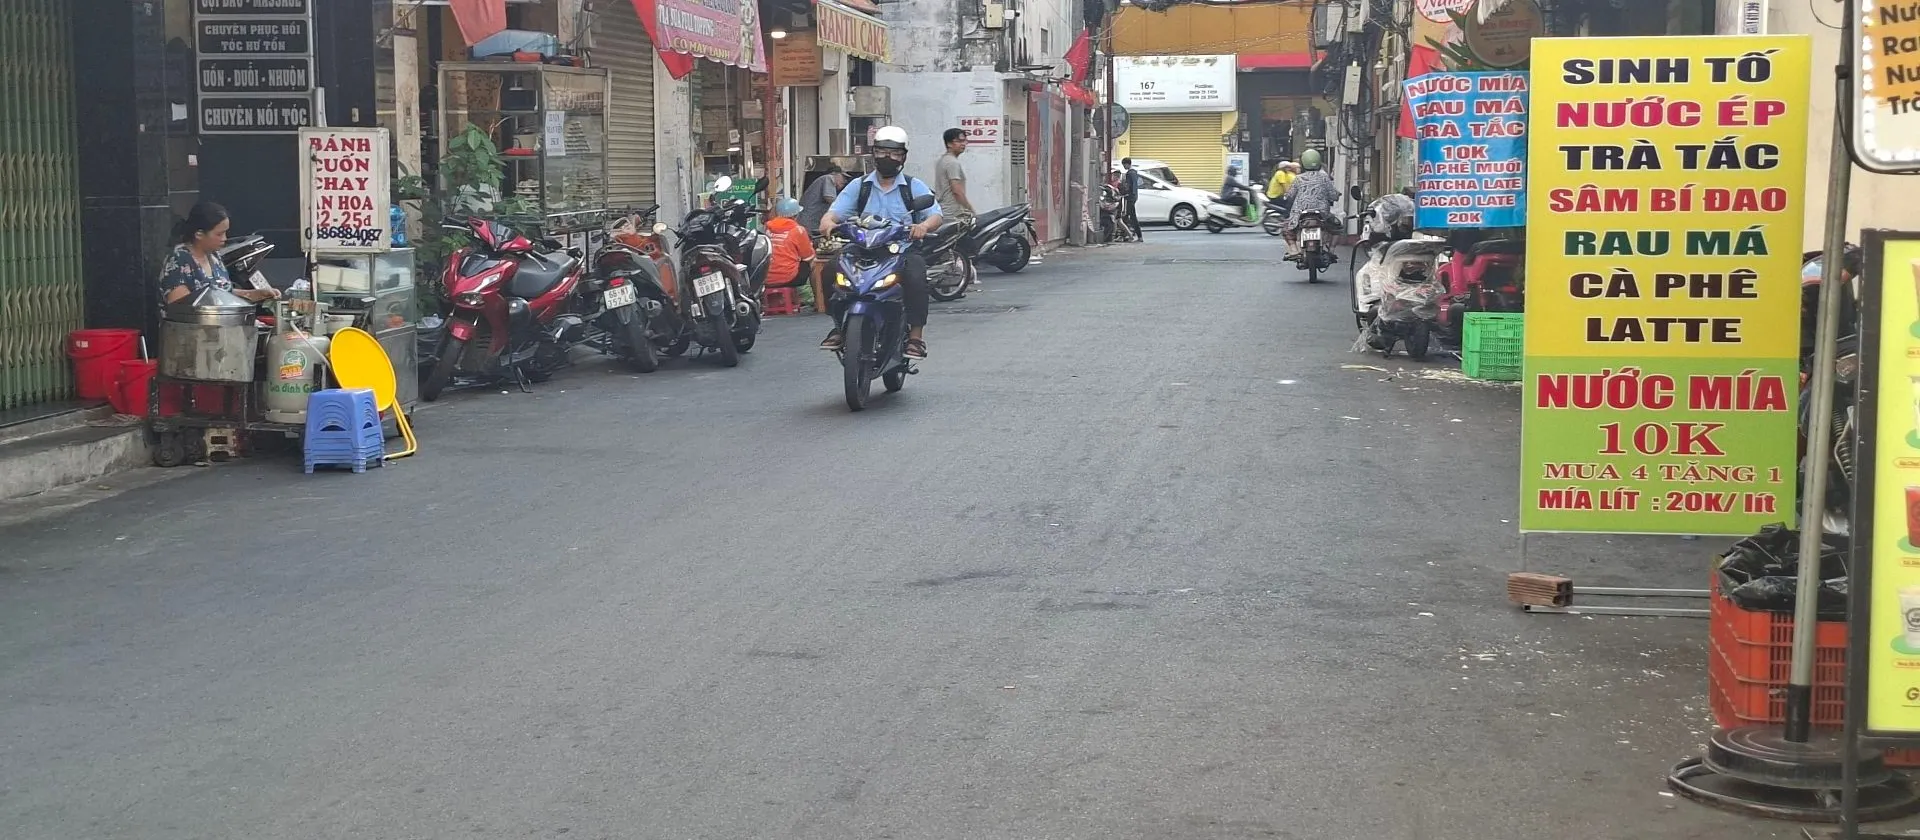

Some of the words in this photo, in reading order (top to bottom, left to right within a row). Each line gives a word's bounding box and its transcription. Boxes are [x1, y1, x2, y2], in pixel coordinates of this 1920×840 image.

[1882, 36, 1920, 56] Ra
[203, 63, 225, 87] UỐN
[268, 65, 306, 90] NHUỘM
[1562, 57, 1690, 85] SINH
[1703, 49, 1782, 83] TỐ
[1140, 81, 1155, 90] 167
[1407, 74, 1471, 98] NƯỚC
[1479, 73, 1526, 92] MÍA
[204, 104, 253, 126] CHUYÊN
[257, 101, 278, 126] NỐI
[282, 104, 308, 126] TÓC
[1475, 96, 1525, 115] MÁ
[1557, 95, 1701, 128] NƯỚC
[1717, 95, 1786, 126] ÉP
[987, 129, 998, 137] 2
[1469, 117, 1525, 138] TẮC
[309, 134, 371, 152] BÁNH
[1443, 145, 1488, 160] 10K
[1559, 139, 1662, 170] TRÀ
[1674, 136, 1779, 170] TẮC
[1437, 160, 1470, 174] PHÊ
[1476, 158, 1521, 173] MUỐI
[1483, 178, 1522, 189] LATE
[338, 195, 374, 210] HOA
[1420, 195, 1471, 207] CACAO
[1477, 195, 1515, 206] LATE
[1549, 184, 1639, 213] SÂM
[1650, 184, 1697, 212] BÍ
[1703, 187, 1787, 212] ĐAO
[1448, 212, 1481, 224] 20K
[1564, 230, 1670, 256] RAU
[1685, 225, 1769, 256] MÁ
[1569, 268, 1640, 298] CÀ
[1654, 268, 1758, 298] PHÊ
[1586, 317, 1742, 343] LATTE
[1537, 367, 1675, 410] NƯỚC
[1688, 369, 1788, 411] MÍA
[1598, 422, 1726, 456] 10K
[1543, 463, 1621, 480] MUA
[1631, 463, 1649, 480] 4
[1659, 462, 1757, 485] TẶNG
[1768, 466, 1782, 482] 1
[1538, 486, 1593, 510] MÍA
[1599, 486, 1640, 511] LÍT
[1744, 492, 1777, 513] lít
